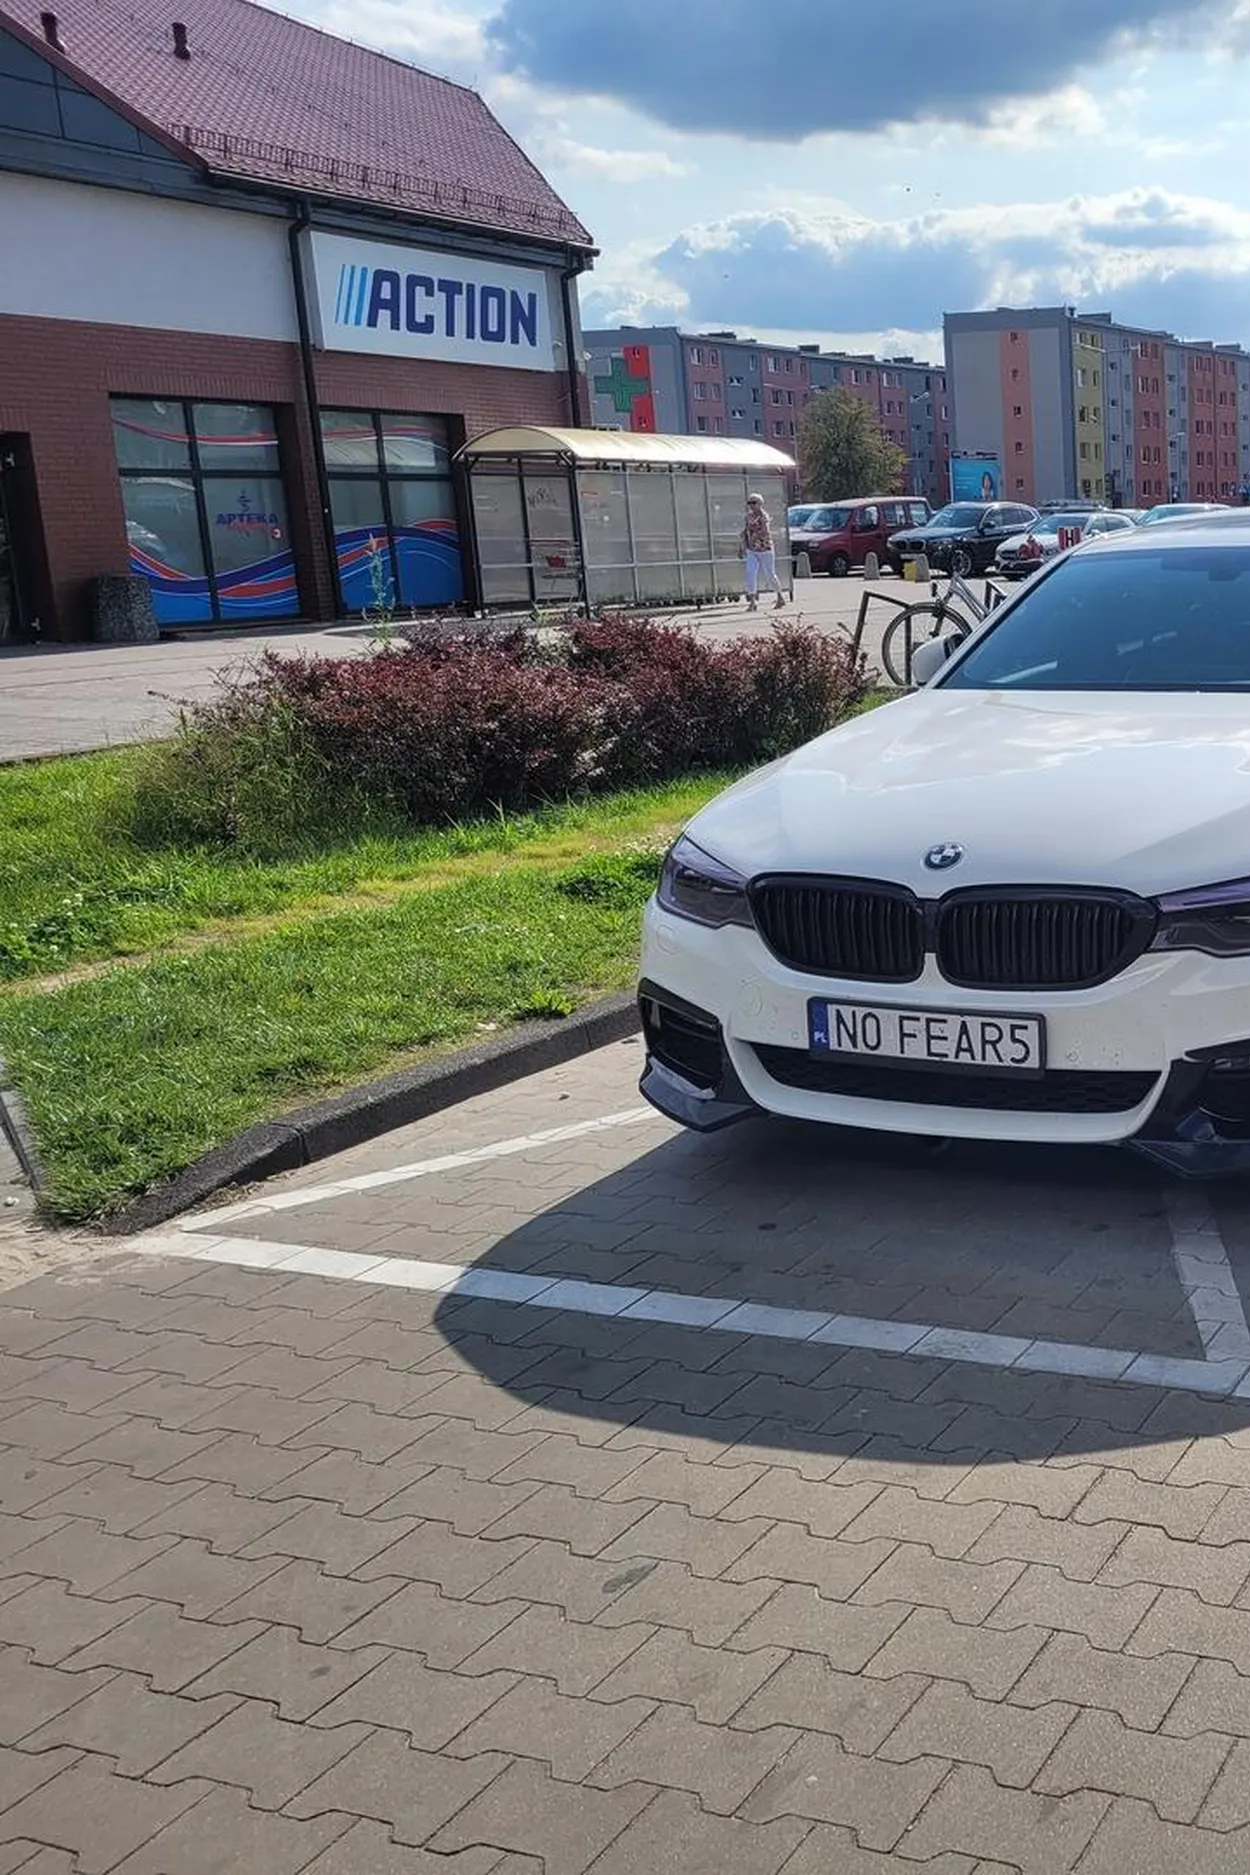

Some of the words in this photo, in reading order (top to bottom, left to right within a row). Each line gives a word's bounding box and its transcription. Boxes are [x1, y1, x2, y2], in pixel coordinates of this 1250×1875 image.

[367, 269, 537, 346] ACTION
[216, 513, 279, 525] APTEKA
[898, 1015, 1030, 1064] FEAR5
